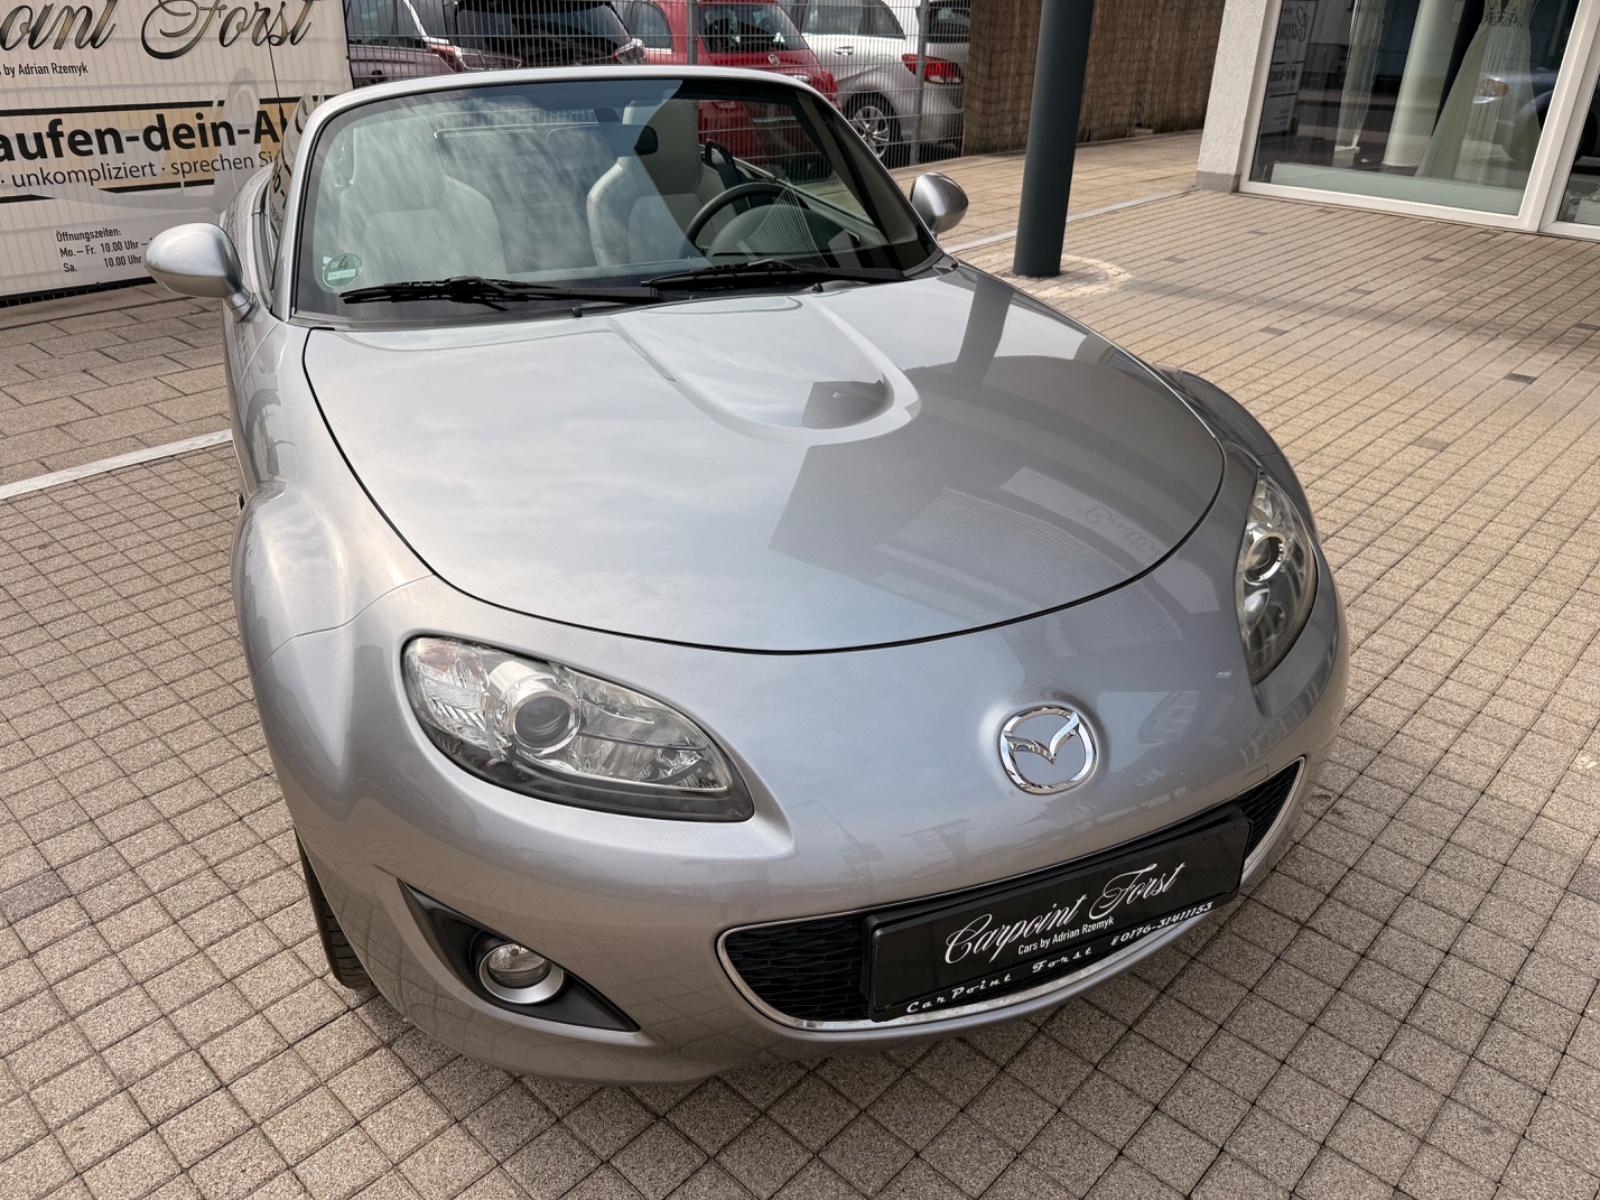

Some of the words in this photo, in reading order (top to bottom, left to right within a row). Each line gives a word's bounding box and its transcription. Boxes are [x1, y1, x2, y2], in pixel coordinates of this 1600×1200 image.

[3, 64, 15, 78] by
[18, 63, 50, 76] Adrian
[51, 62, 89, 76] Rzemyk
[0, 110, 284, 162] aufen-dein-A
[11, 162, 158, 188] unkompliziert
[171, 154, 254, 178] sprechen
[56, 228, 122, 243] Öffnungszeiten:
[100, 241, 123, 254] 10.00
[124, 240, 140, 250] Uhr
[63, 262, 78, 273] Sa.
[103, 255, 127, 269] 10.00
[128, 255, 142, 265] Uhr
[945, 893, 1088, 964] Carpoint
[1088, 862, 1187, 920] Forst
[1017, 943, 1038, 956] Cars
[1040, 938, 1051, 949] by
[1052, 928, 1080, 944] Adrian
[1081, 916, 1115, 934] Rzemyk
